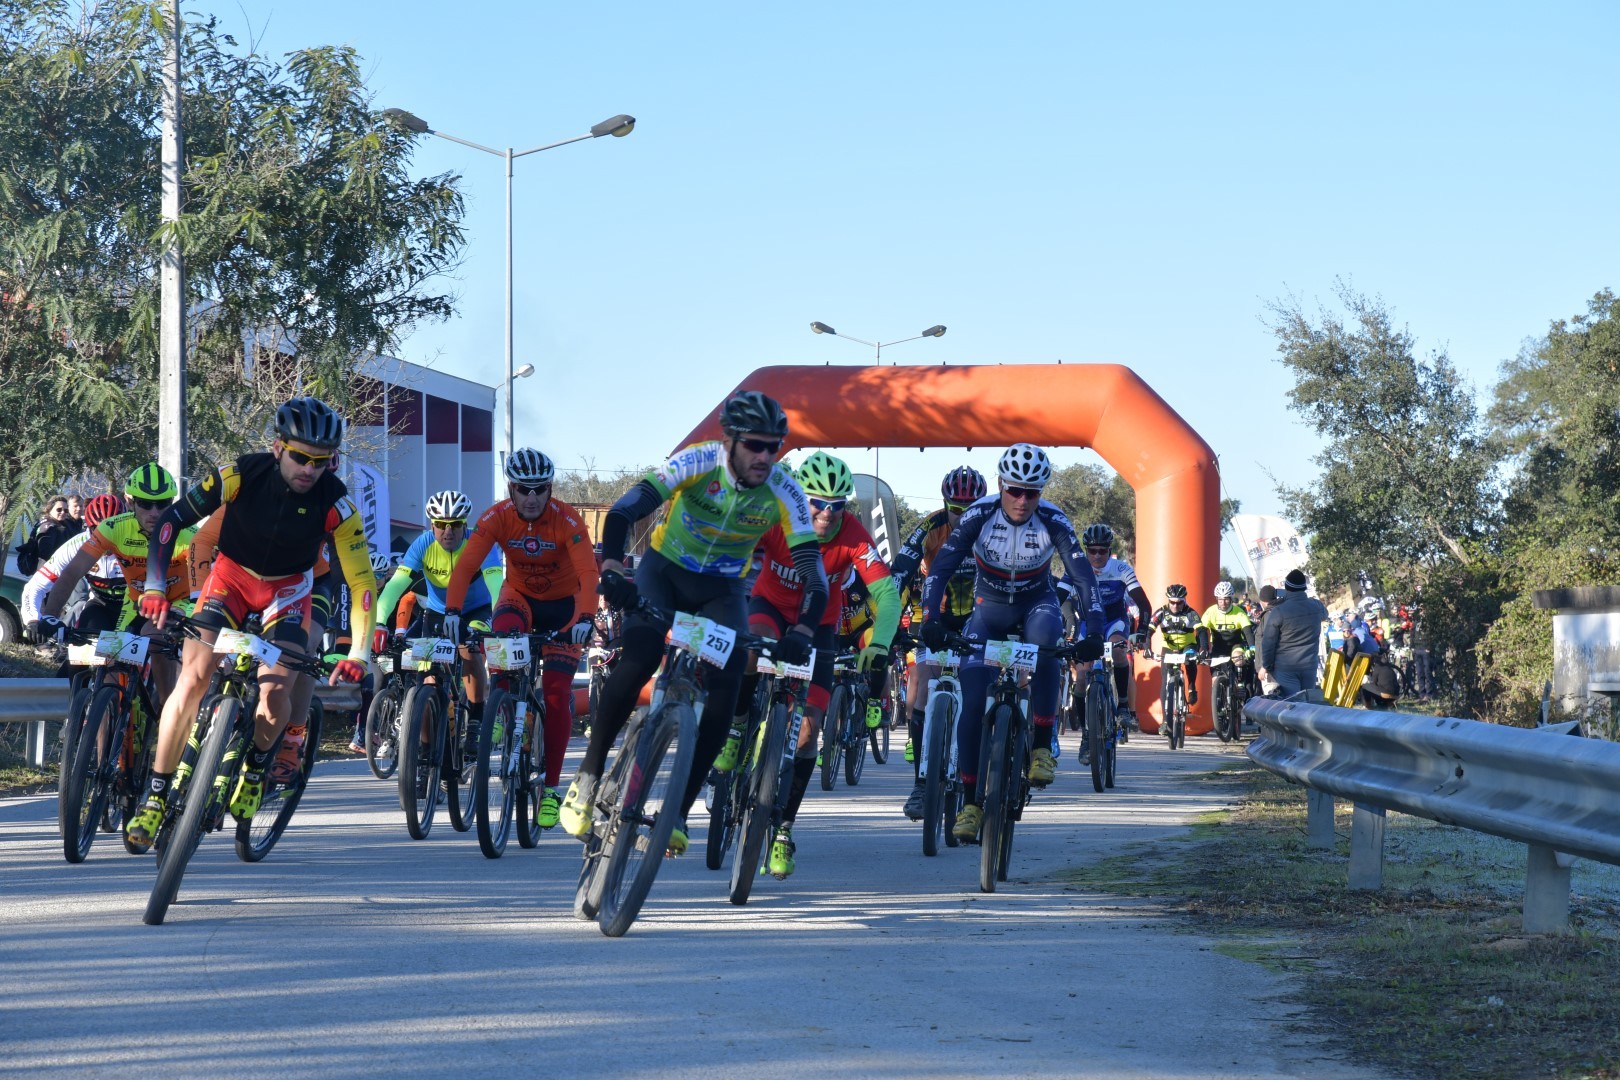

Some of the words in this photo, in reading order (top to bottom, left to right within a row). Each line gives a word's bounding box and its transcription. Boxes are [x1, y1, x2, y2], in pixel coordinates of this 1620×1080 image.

[1004, 552, 1042, 561] Liberty
[426, 566, 448, 576] Mais
[130, 643, 139, 655] 3
[706, 634, 731, 654] 257
[512, 650, 525, 661] 10
[1014, 649, 1035, 661] 212
